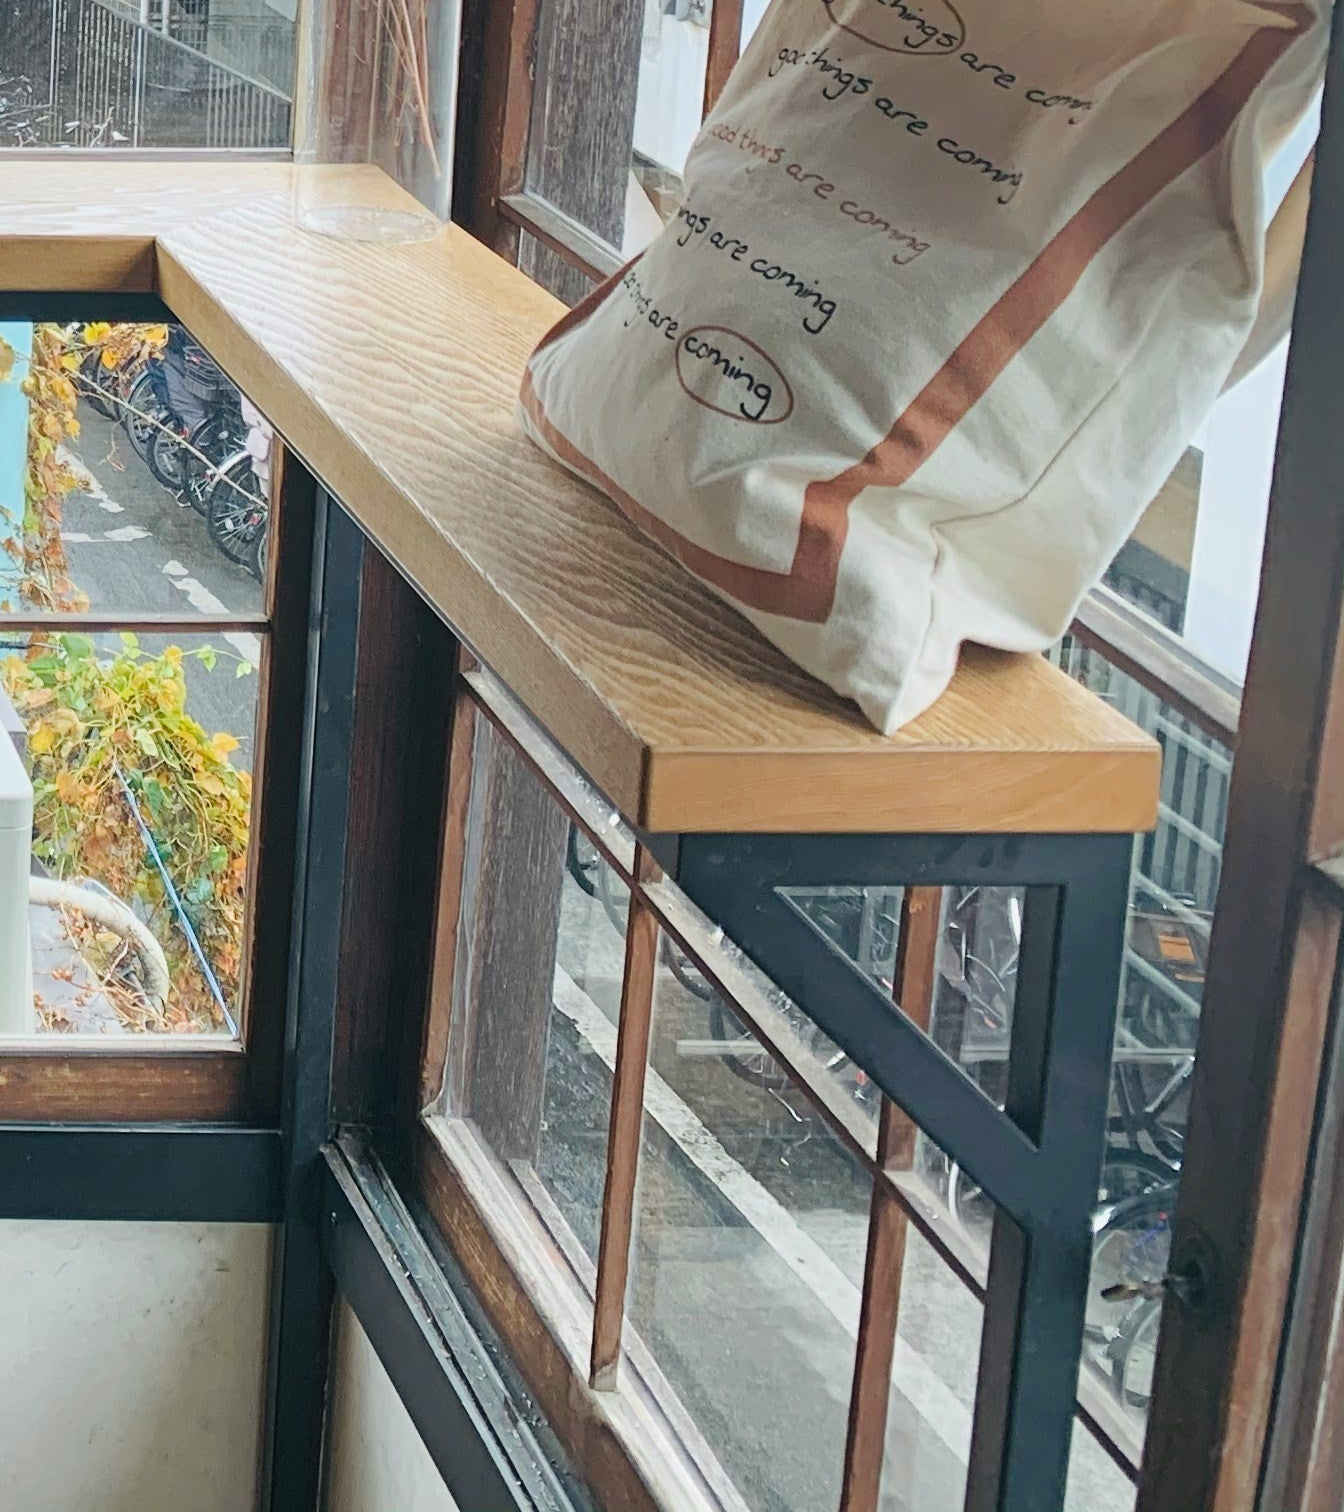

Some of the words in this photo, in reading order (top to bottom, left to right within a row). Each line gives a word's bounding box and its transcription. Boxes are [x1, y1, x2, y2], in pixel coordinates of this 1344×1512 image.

[960, 52, 1016, 89] are
[874, 97, 929, 136] are
[786, 163, 835, 200] are
[710, 231, 749, 262] are
[750, 258, 837, 335] coming
[648, 309, 679, 341] are
[684, 335, 773, 421] coming
